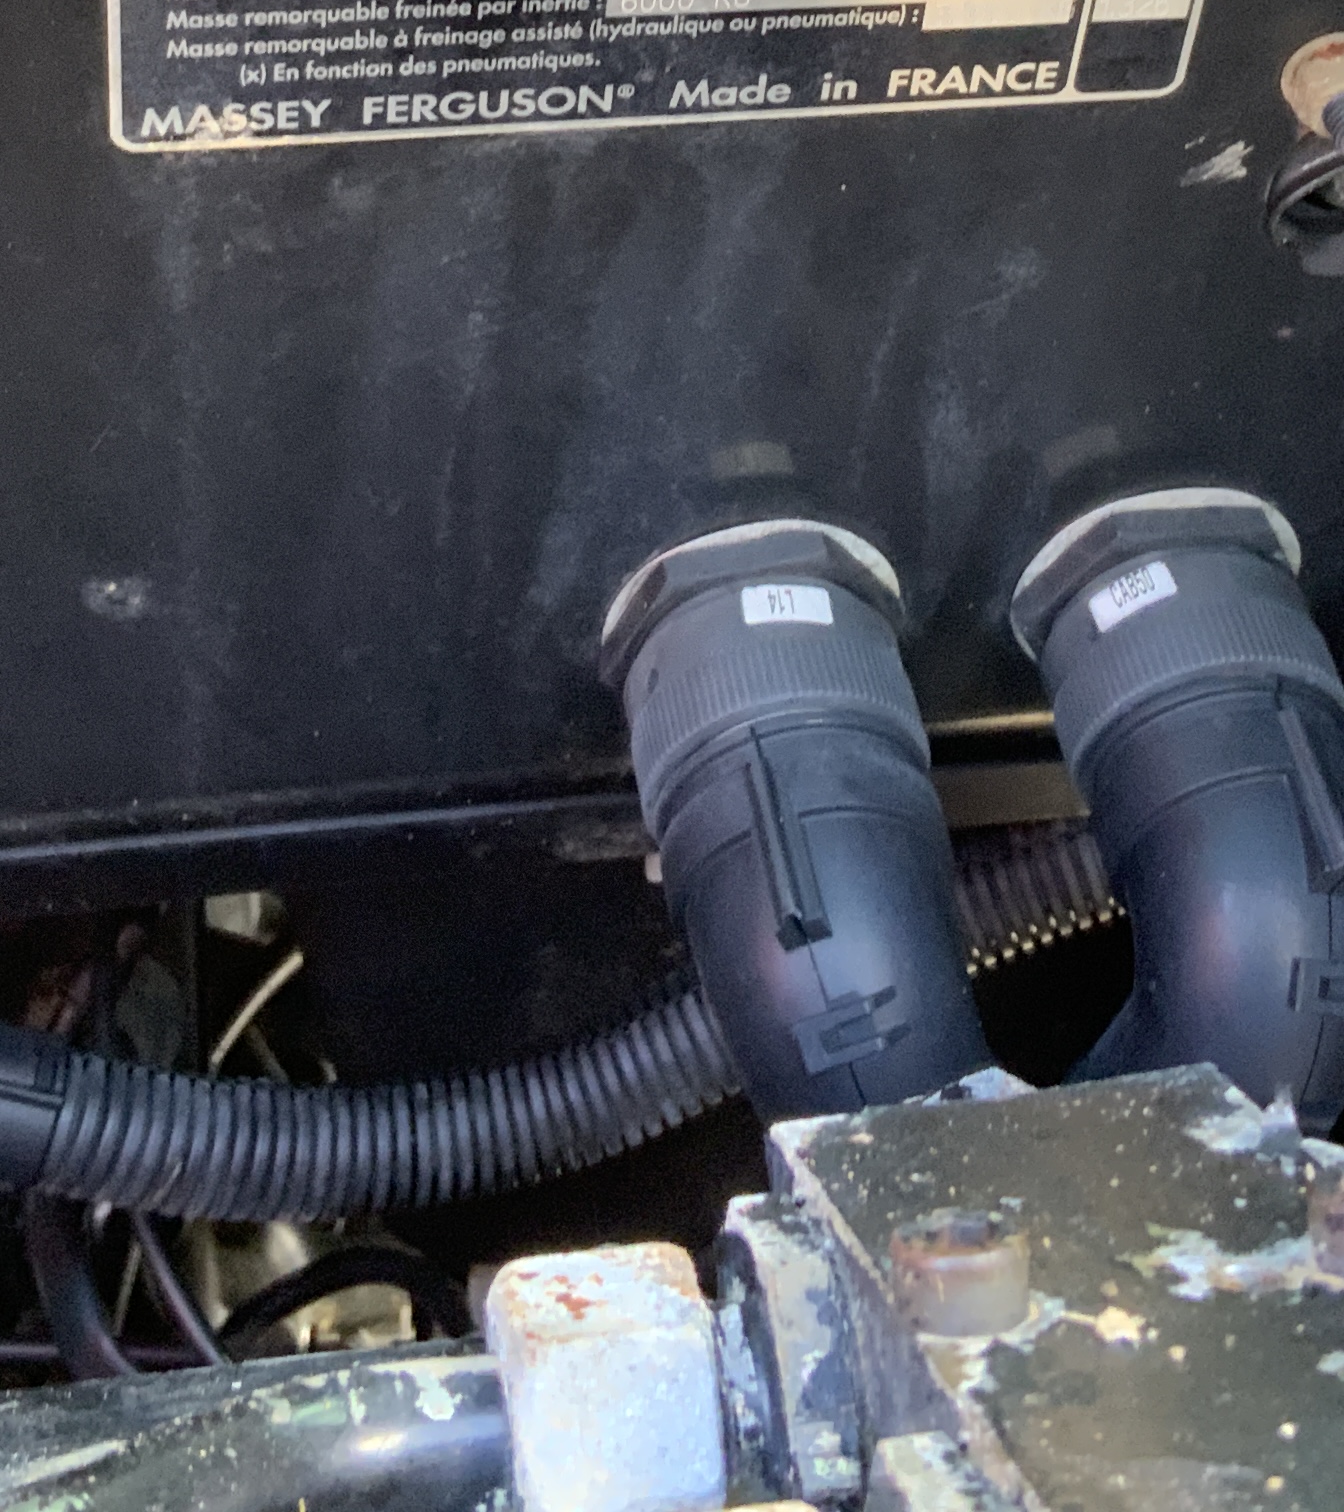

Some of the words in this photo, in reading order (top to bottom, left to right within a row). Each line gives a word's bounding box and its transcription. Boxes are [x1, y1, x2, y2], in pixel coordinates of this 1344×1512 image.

[166, 9, 237, 32] Masse
[245, 1, 388, 29] remorquable
[478, 0, 515, 22] par
[166, 37, 237, 60] Masse
[244, 28, 388, 57] remorquable
[415, 23, 506, 50] freinage
[512, 21, 582, 43] assisté
[590, 13, 723, 44] (hydraulique
[730, 17, 756, 32] ou
[763, 5, 906, 36] pneumatique)
[273, 64, 299, 82] En
[305, 58, 393, 82] fonction
[399, 56, 436, 77] des
[443, 48, 600, 78] pneumatiques.
[140, 99, 331, 138] MASSEY
[669, 74, 790, 109] Made
[821, 70, 857, 101] in
[887, 60, 1059, 97] FRANCE
